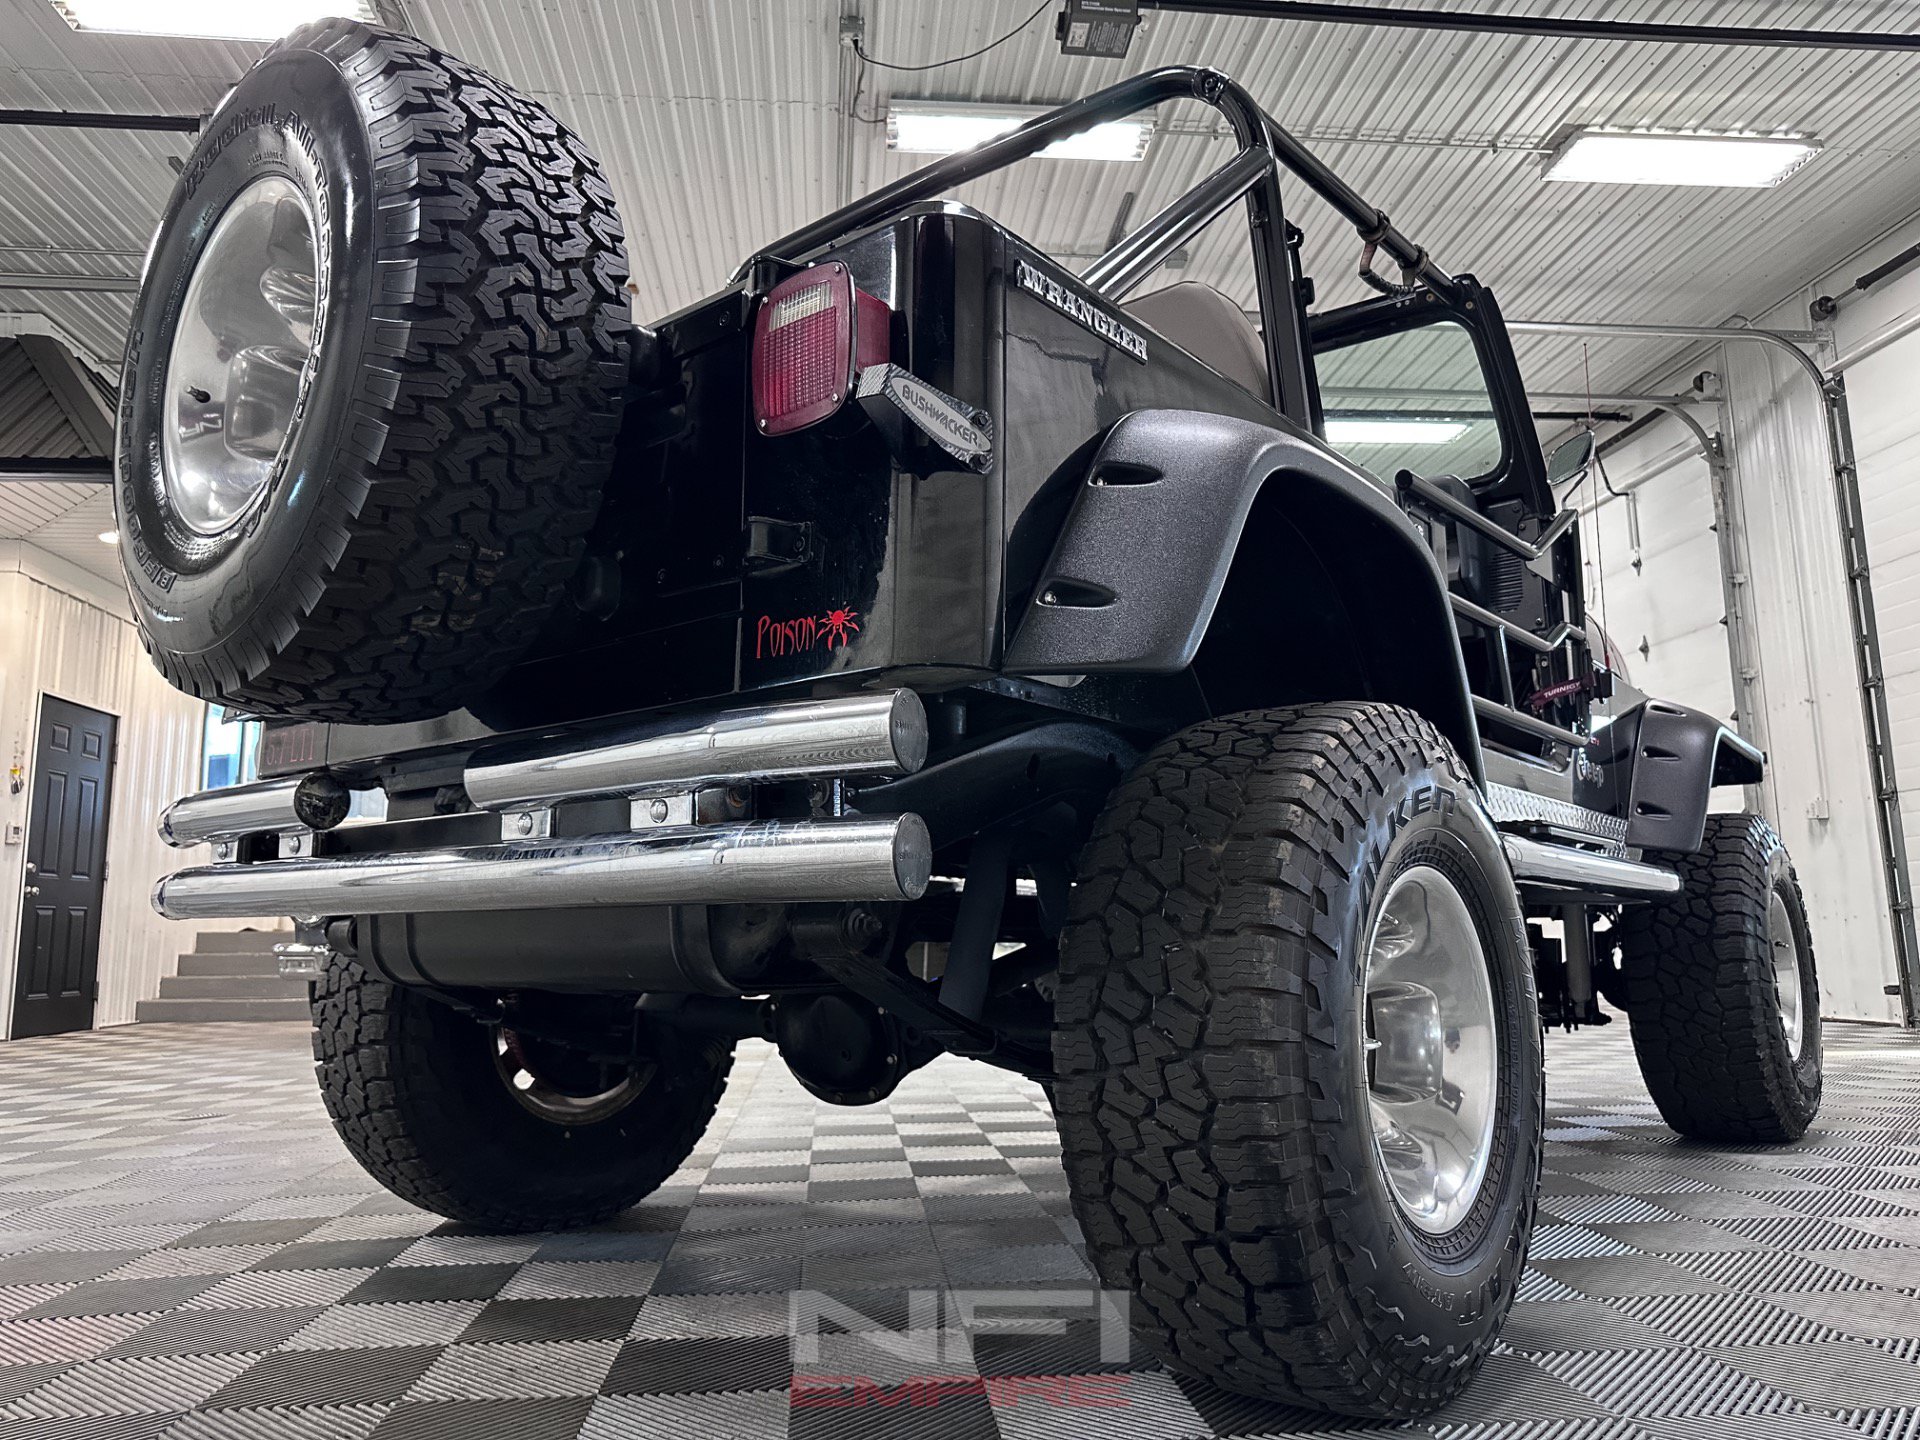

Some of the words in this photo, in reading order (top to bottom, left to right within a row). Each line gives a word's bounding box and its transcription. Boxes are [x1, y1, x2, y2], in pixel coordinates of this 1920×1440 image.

[1017, 259, 1148, 361] WRANGLER
[902, 384, 978, 446] BUSHWACKER
[1543, 681, 1581, 698] TURNIGY
